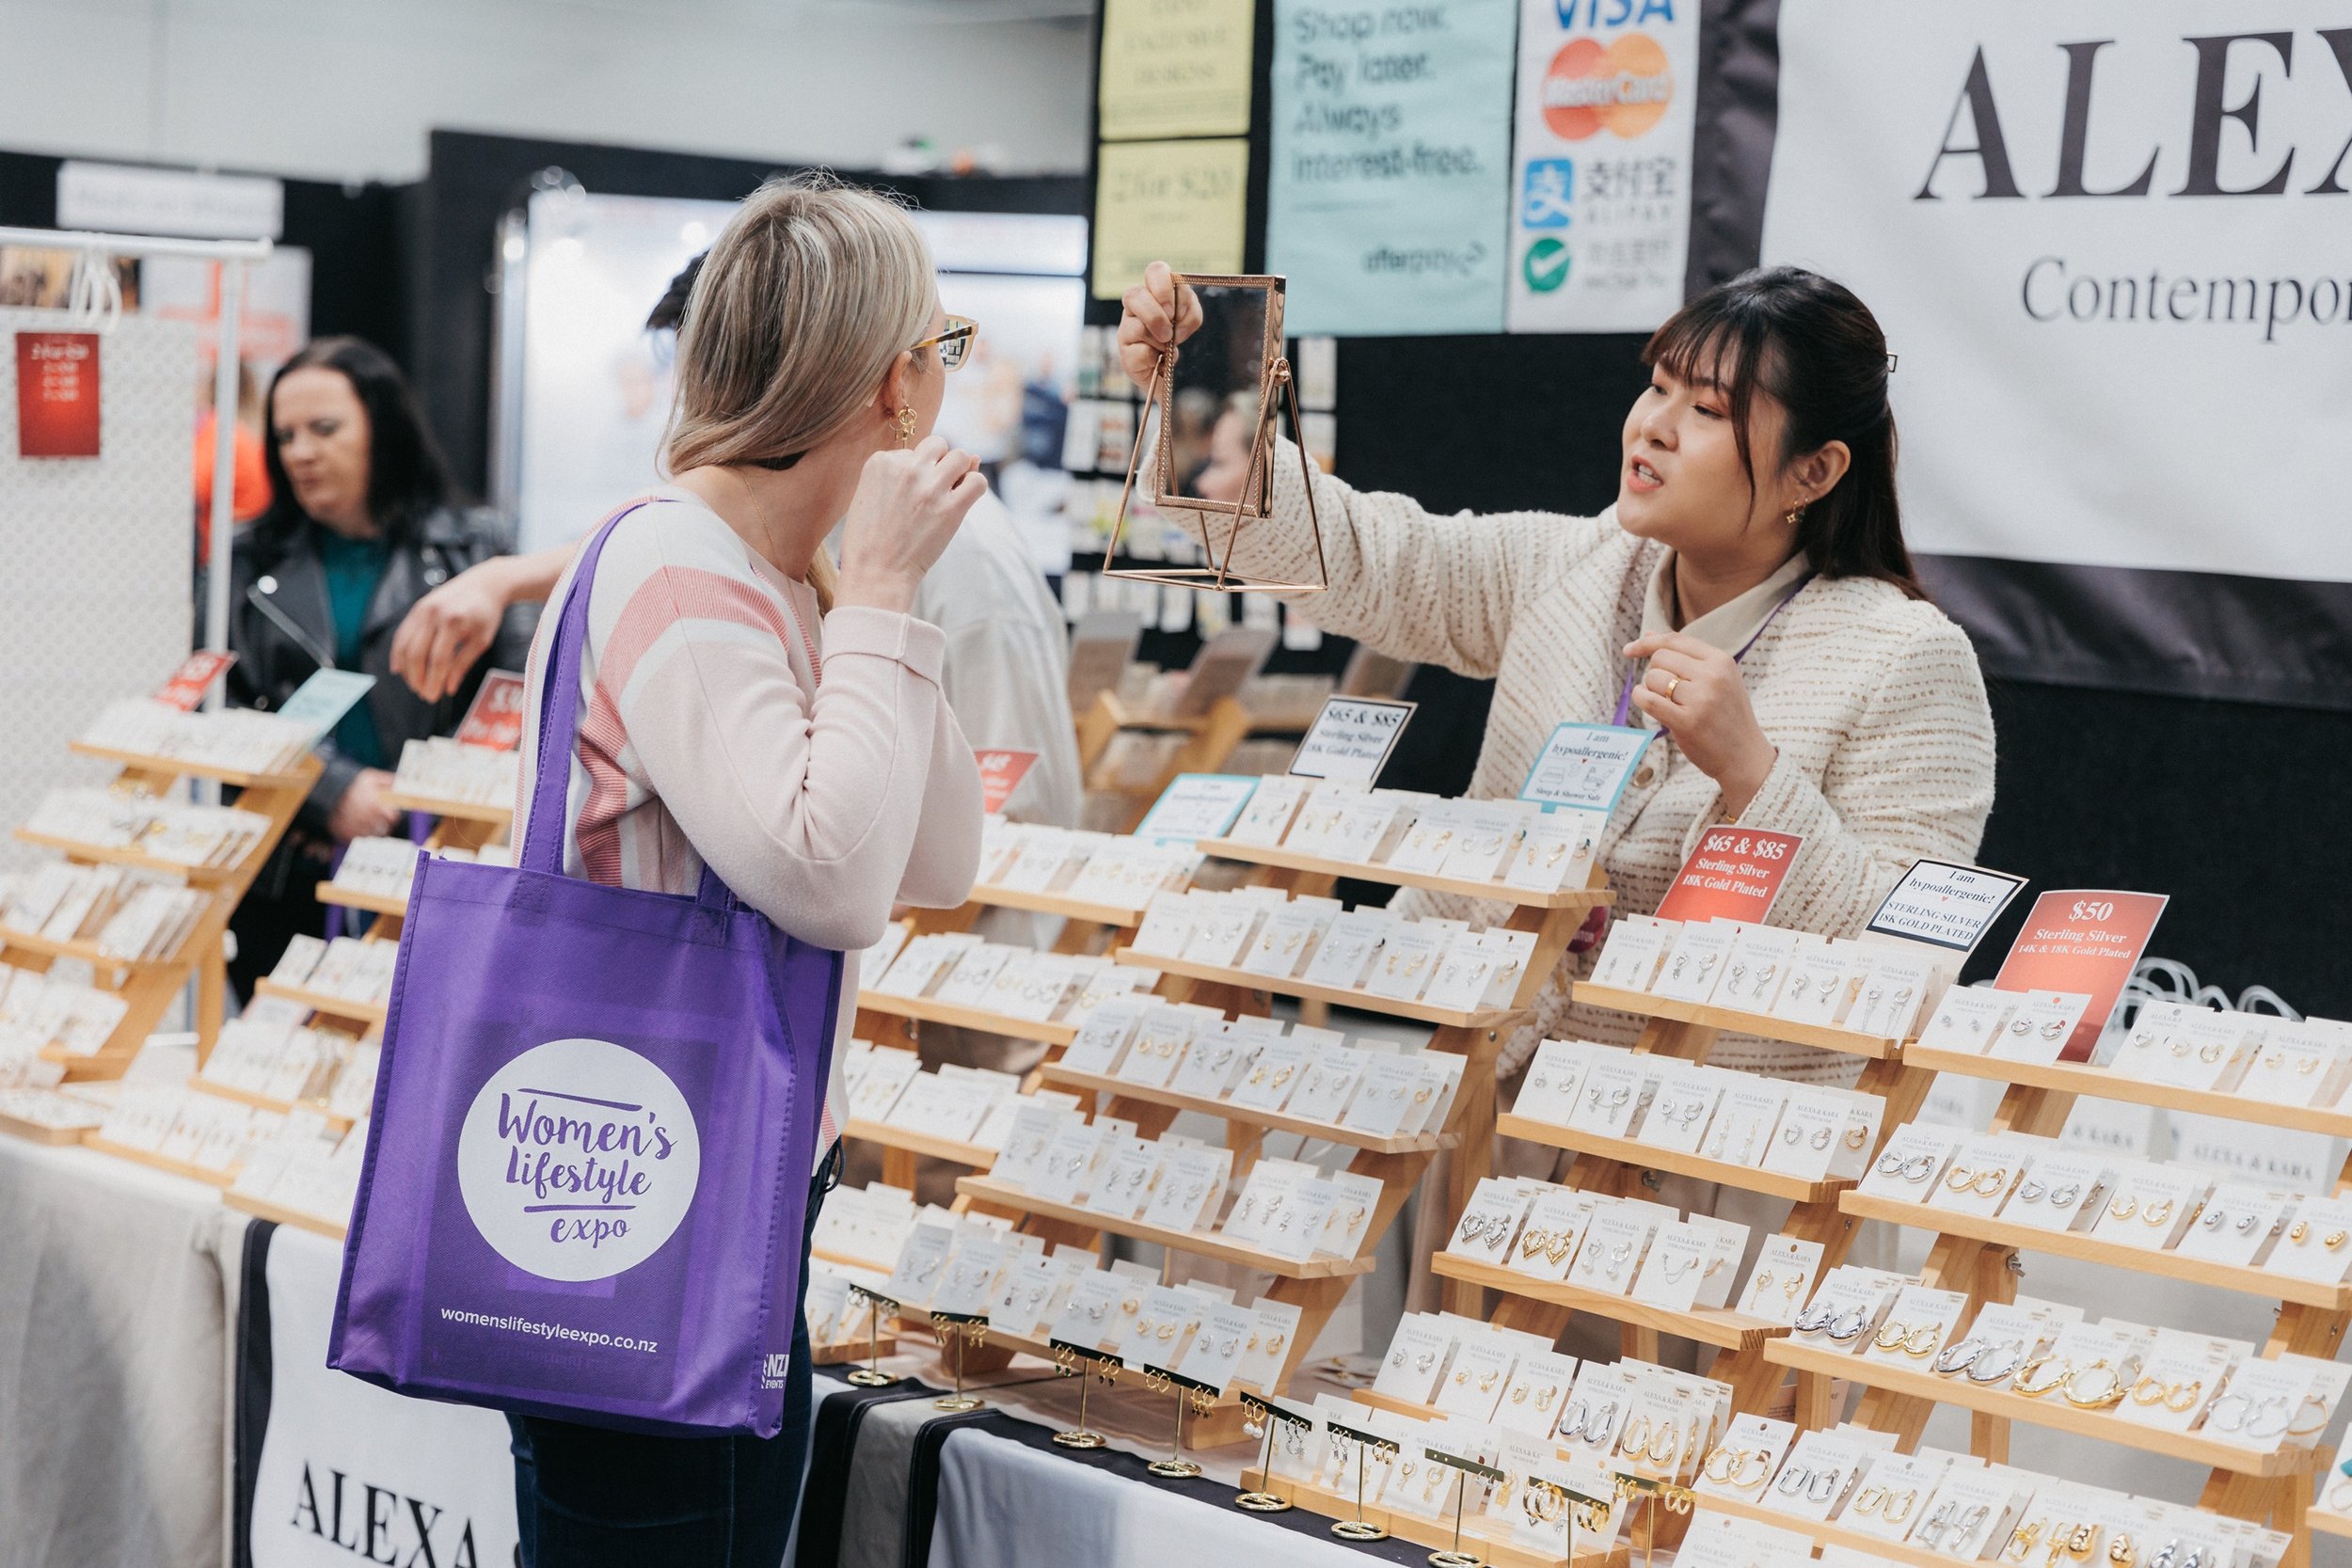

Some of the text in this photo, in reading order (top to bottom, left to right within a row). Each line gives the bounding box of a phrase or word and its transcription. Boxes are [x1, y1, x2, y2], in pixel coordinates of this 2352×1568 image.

[1556, 0, 1674, 29] VISA
[1552, 744, 1629, 761] hypoallergenic!
[1704, 834, 1788, 860] $65 & $85
[1695, 858, 1770, 879] Sterling Silver
[1948, 871, 1976, 884] I am
[1682, 874, 1768, 898] 18K Gold Plated
[1909, 878, 1995, 904] hypoallergenic!
[1887, 900, 1982, 929] STERLING SILVER
[2068, 899, 2114, 922] $50
[1898, 917, 1929, 931] GOLD
[1931, 925, 1974, 941] PLATED
[2034, 928, 2128, 943] Sterling Silver
[2017, 944, 2132, 958] 14K & 18K Gold Plated
[499, 1093, 677, 1160] Women's
[550, 1218, 630, 1248] expo
[440, 1307, 658, 1353] womenslifestyleexpo.co.nz
[1645, 1391, 1662, 1402] ALEXA
[1667, 1397, 1683, 1407] KARA
[291, 1461, 478, 1568] ALEXA
